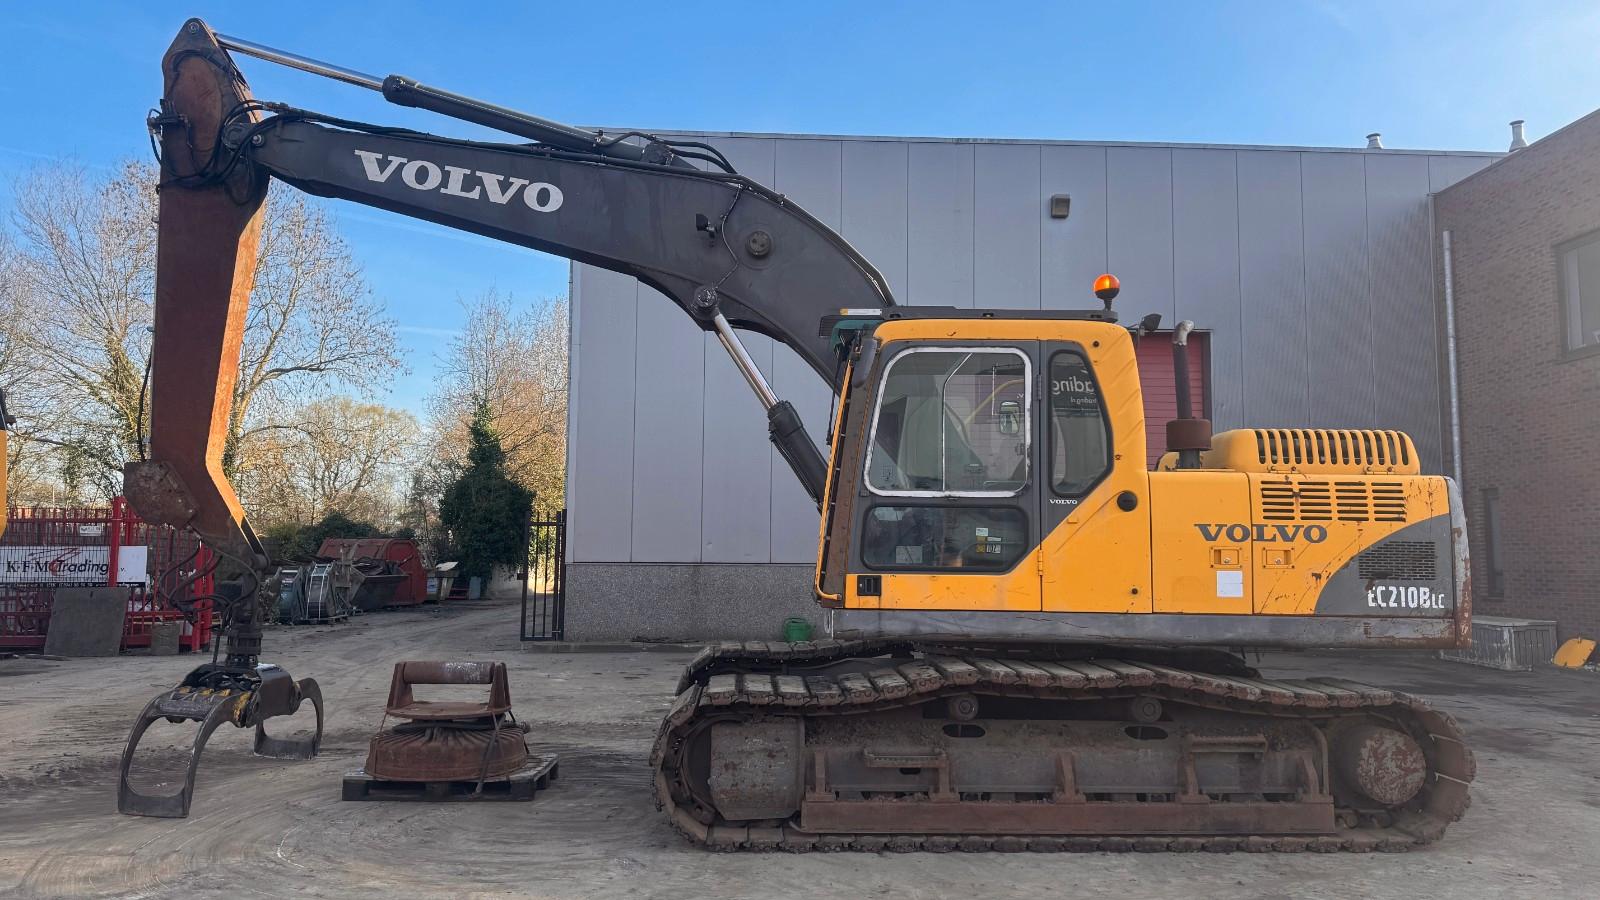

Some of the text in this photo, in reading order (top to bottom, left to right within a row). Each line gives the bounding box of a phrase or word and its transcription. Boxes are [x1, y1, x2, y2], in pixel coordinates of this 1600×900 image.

[354, 149, 564, 213] VOLVO
[1194, 523, 1328, 543] VOLVO
[57, 559, 109, 575] Trading
